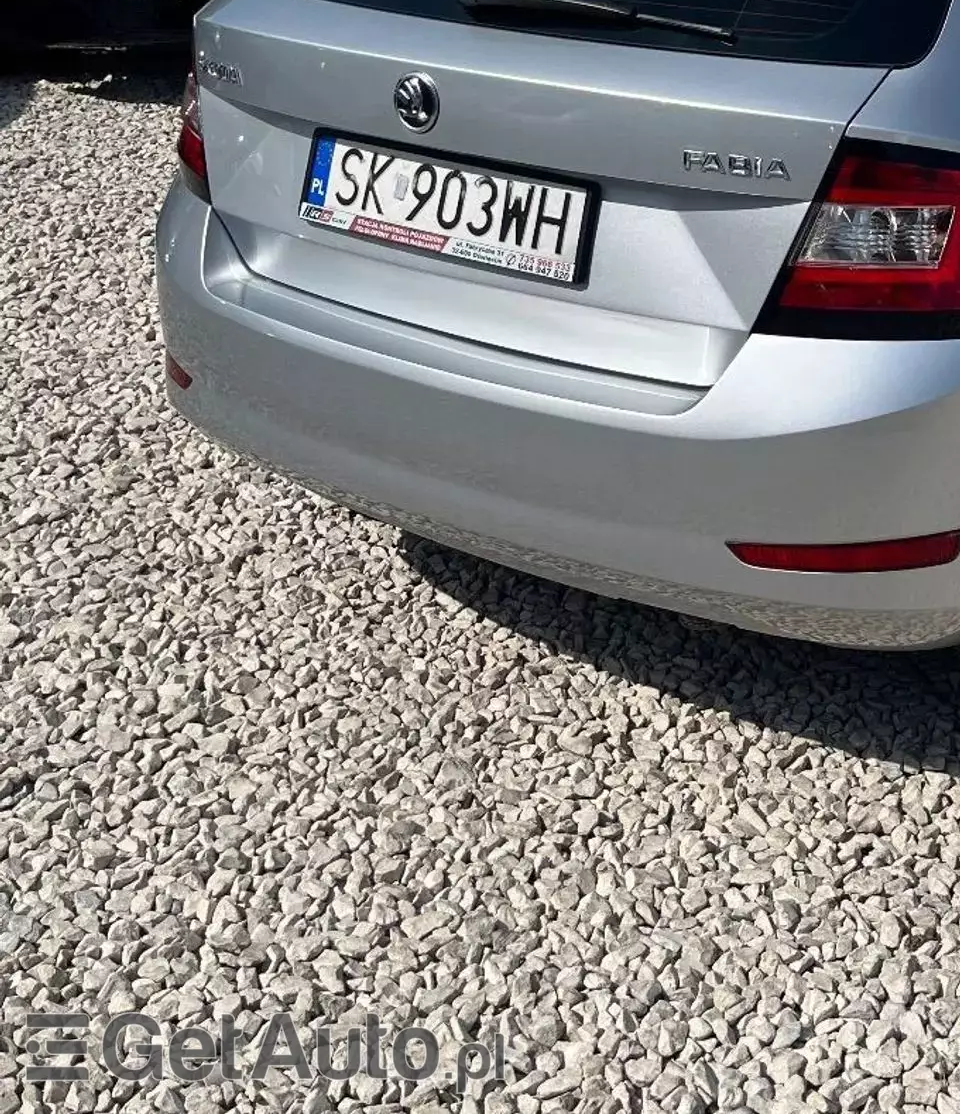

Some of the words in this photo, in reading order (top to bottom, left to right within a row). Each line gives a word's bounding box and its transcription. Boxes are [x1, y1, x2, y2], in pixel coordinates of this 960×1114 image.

[683, 149, 791, 181] FABIA
[311, 177, 325, 196] PL
[335, 147, 395, 216] SK
[405, 162, 571, 255] 903WH
